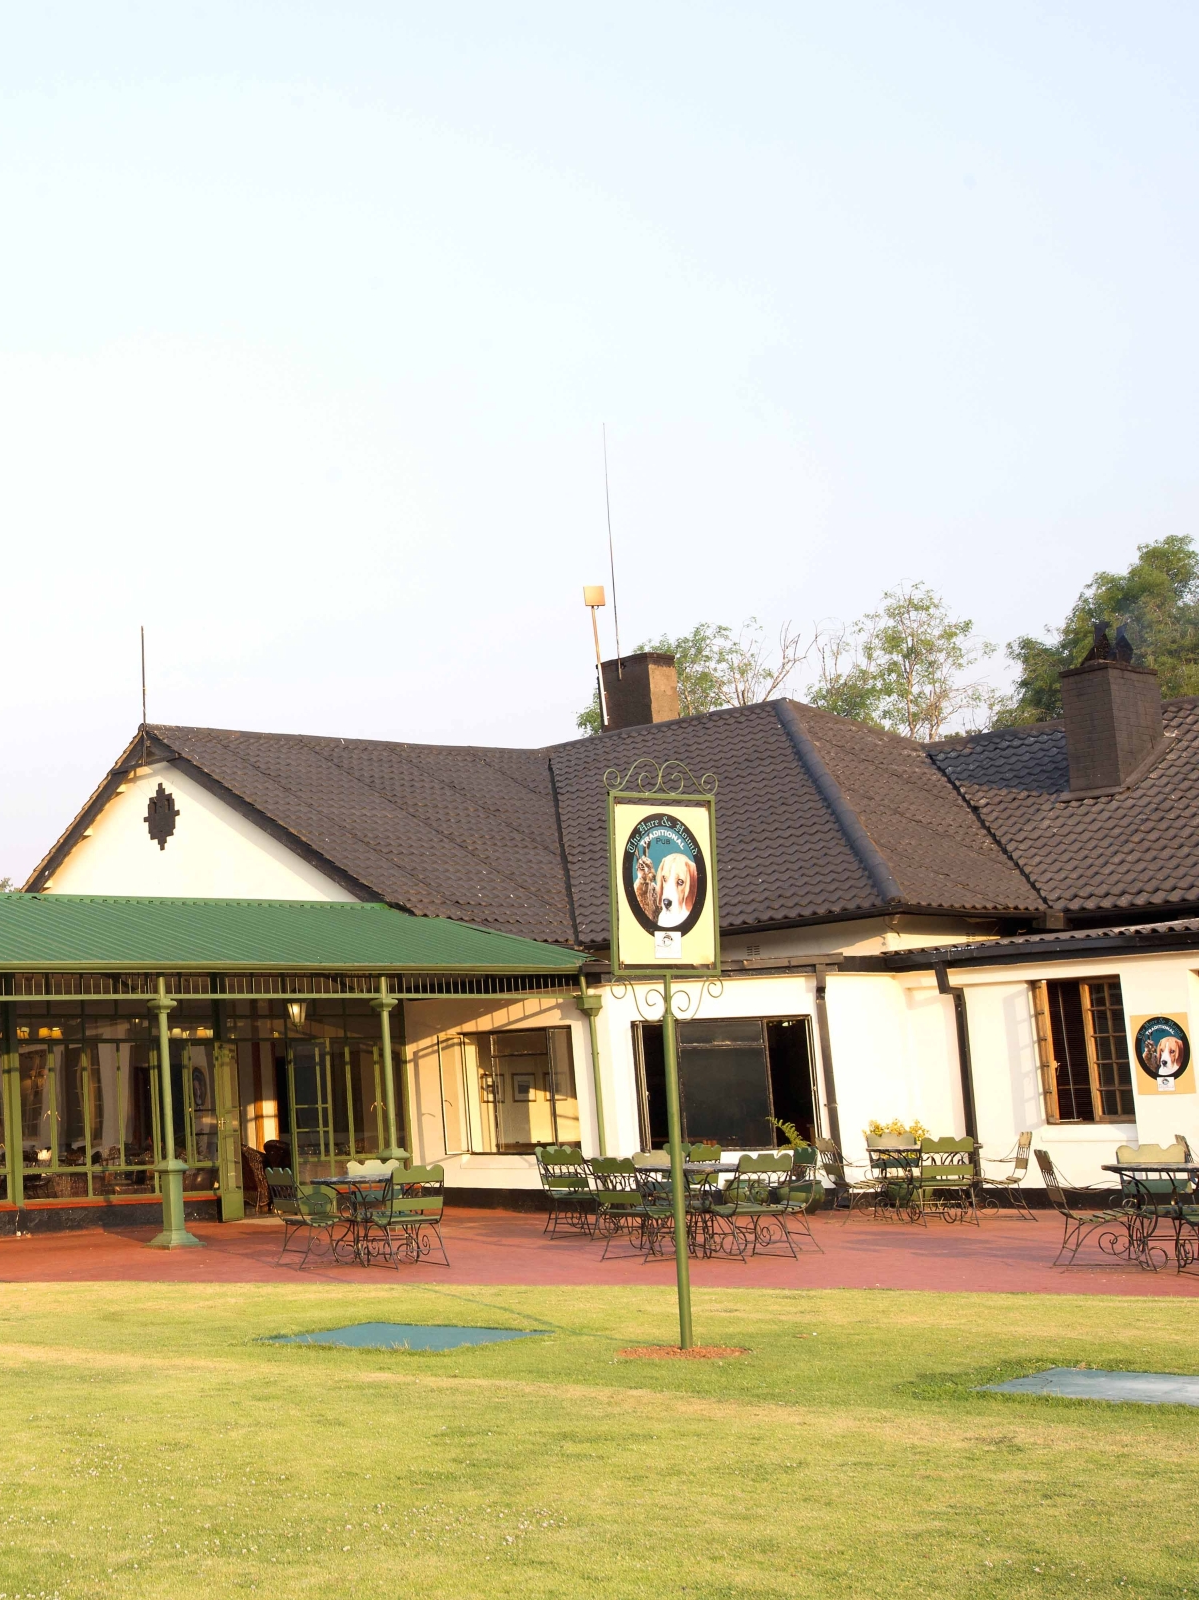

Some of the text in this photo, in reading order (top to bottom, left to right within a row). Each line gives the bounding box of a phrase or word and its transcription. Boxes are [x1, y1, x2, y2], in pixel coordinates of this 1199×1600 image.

[627, 816, 698, 855] The Hare & Hound
[640, 829, 684, 850] TRADITIONAL
[1146, 1025, 1175, 1035] TRADITIONAL
